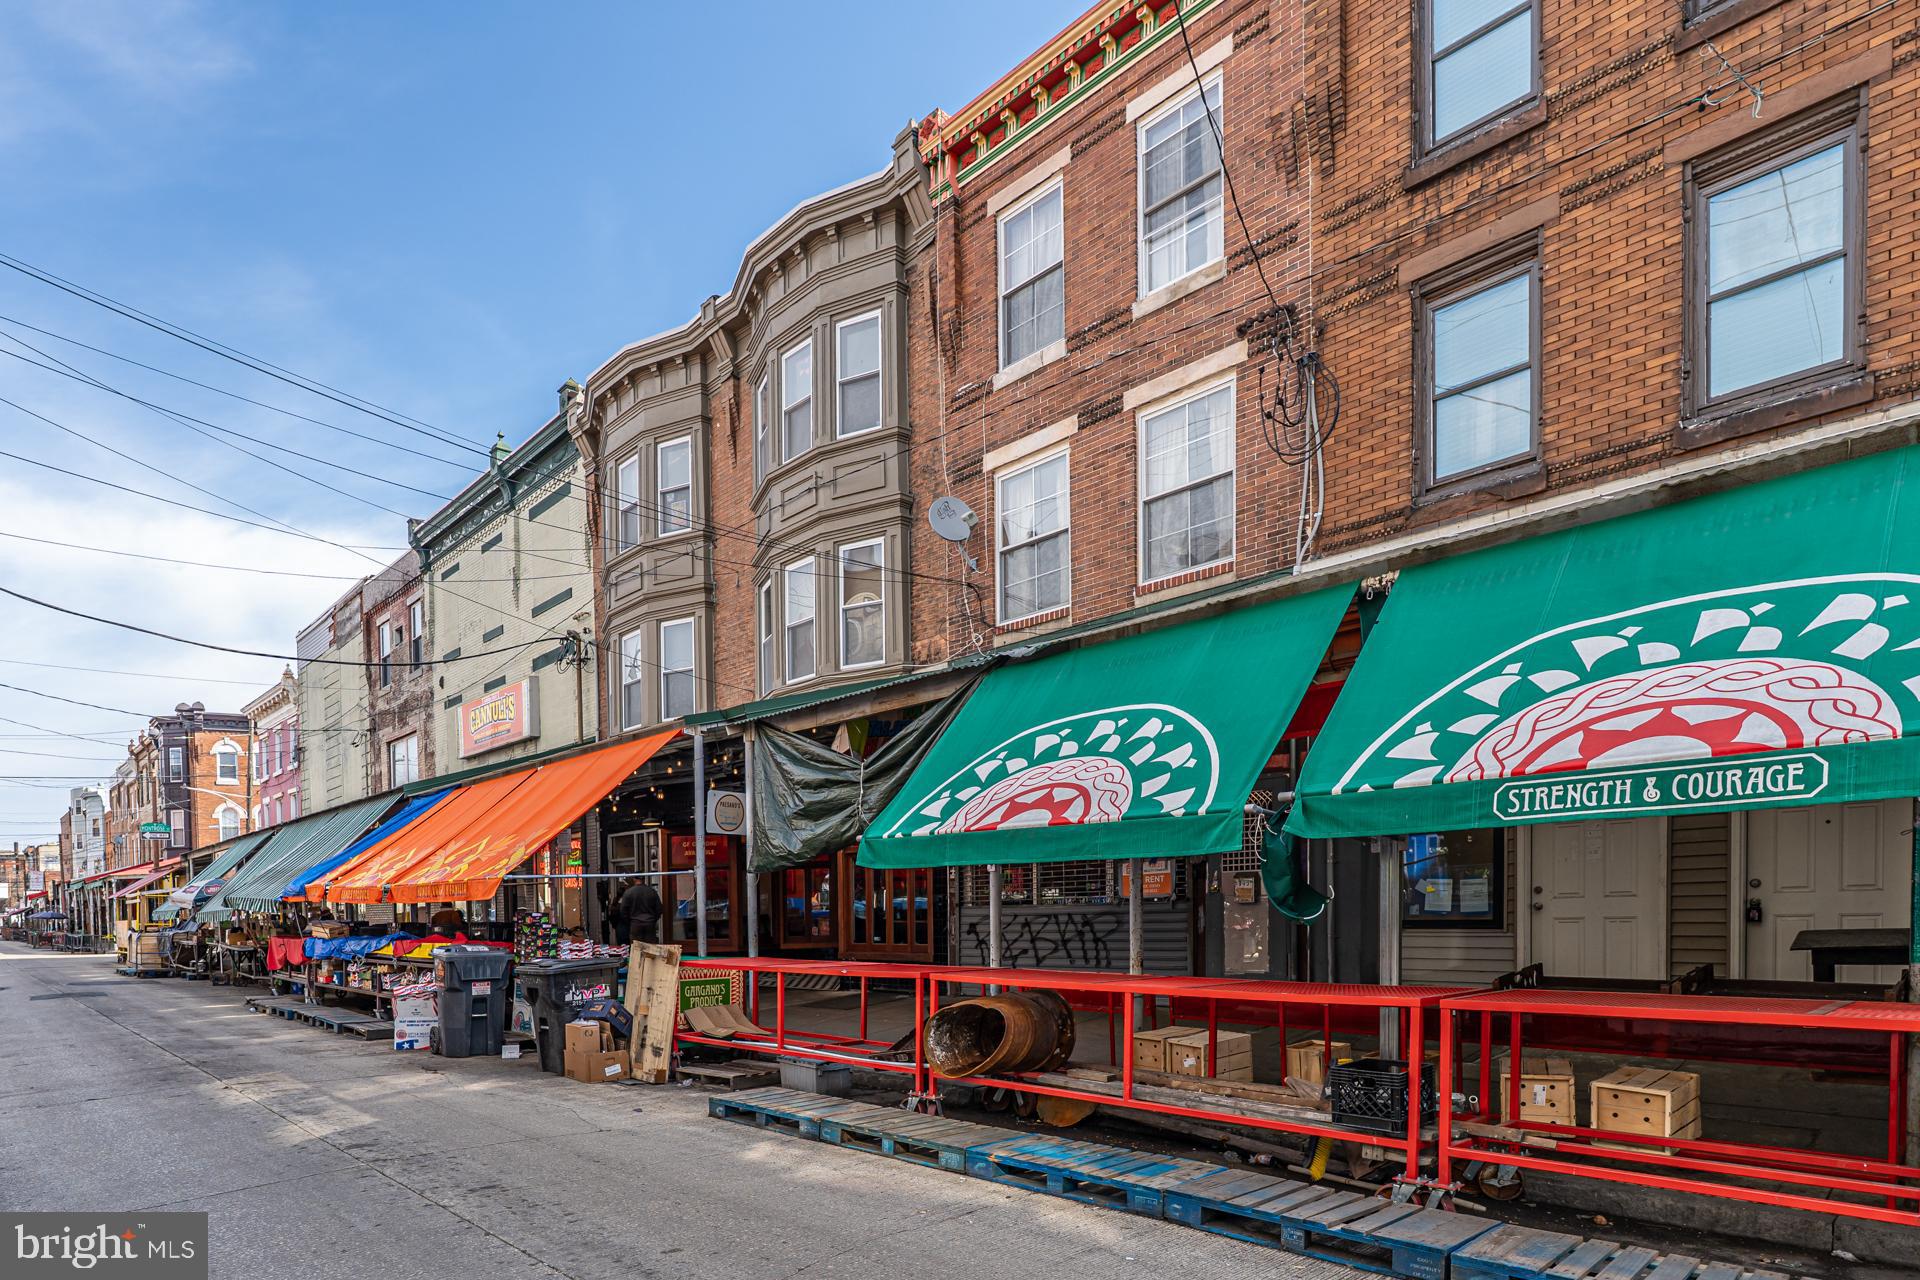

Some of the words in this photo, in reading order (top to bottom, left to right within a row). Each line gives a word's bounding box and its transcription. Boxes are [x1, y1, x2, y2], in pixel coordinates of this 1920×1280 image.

[470, 693, 515, 736] CANNULI'S
[1507, 778, 1633, 815] STRENGTH
[1642, 776, 1661, 802] &
[1671, 762, 1806, 801] COURAGE
[1144, 875, 1165, 884] RENT
[684, 983, 726, 997] GARGANO'S
[690, 995, 723, 1008] PRODUCE
